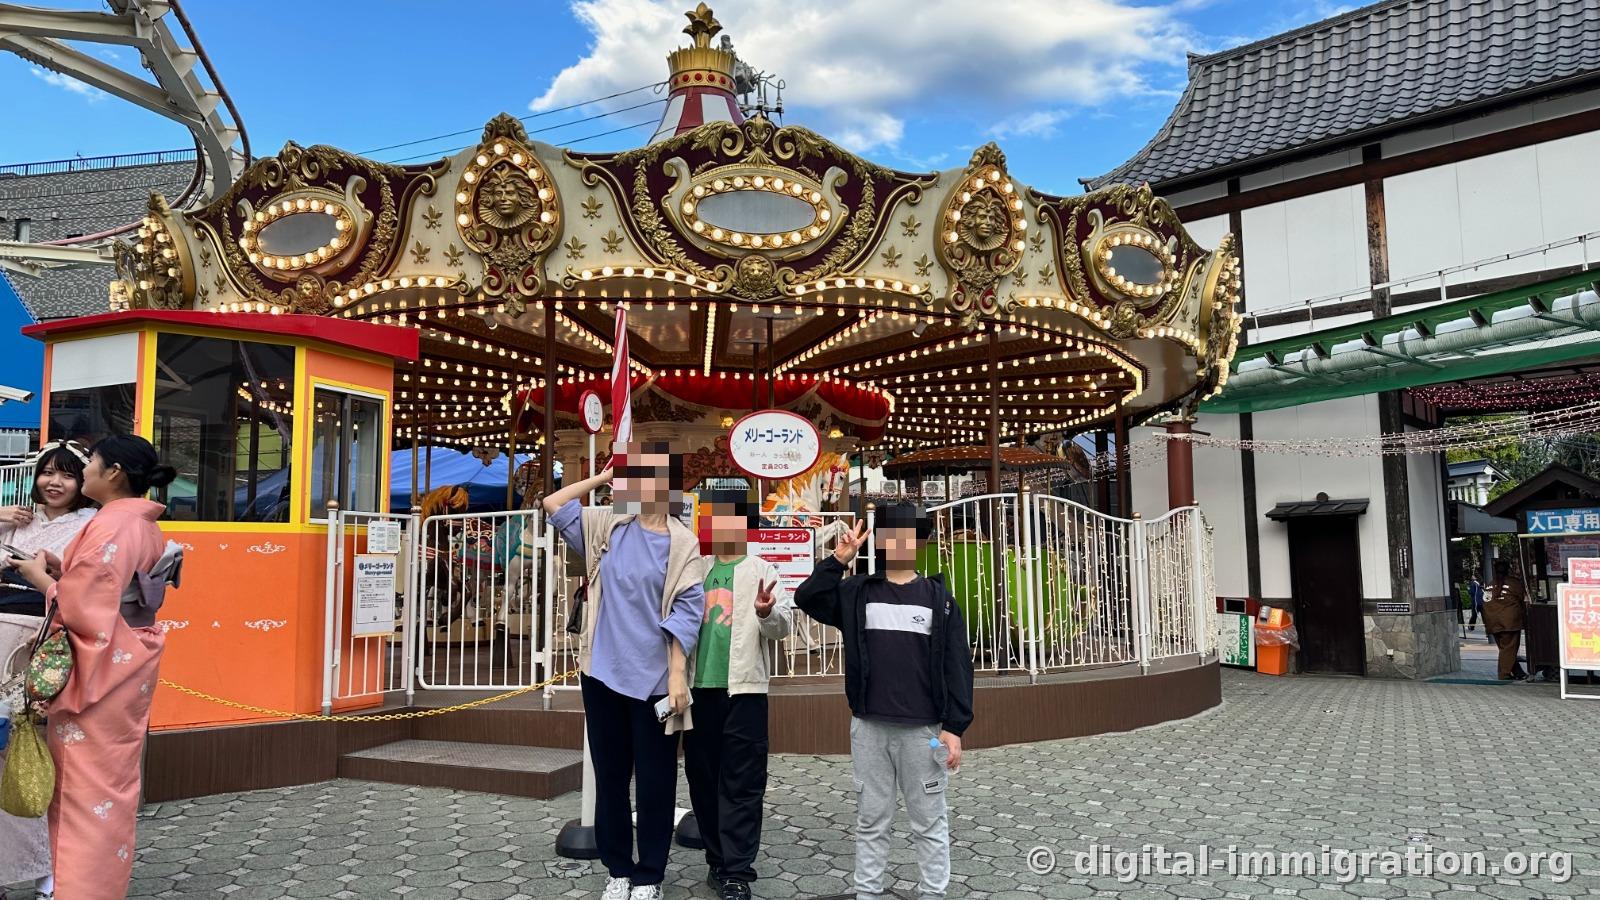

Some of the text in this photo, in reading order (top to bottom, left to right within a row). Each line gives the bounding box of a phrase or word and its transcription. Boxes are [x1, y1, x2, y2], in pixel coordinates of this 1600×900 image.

[744, 428, 803, 444] メリーゴーランド
[1529, 513, 1600, 531] 入口専用
[760, 532, 807, 541] リーゴーランド
